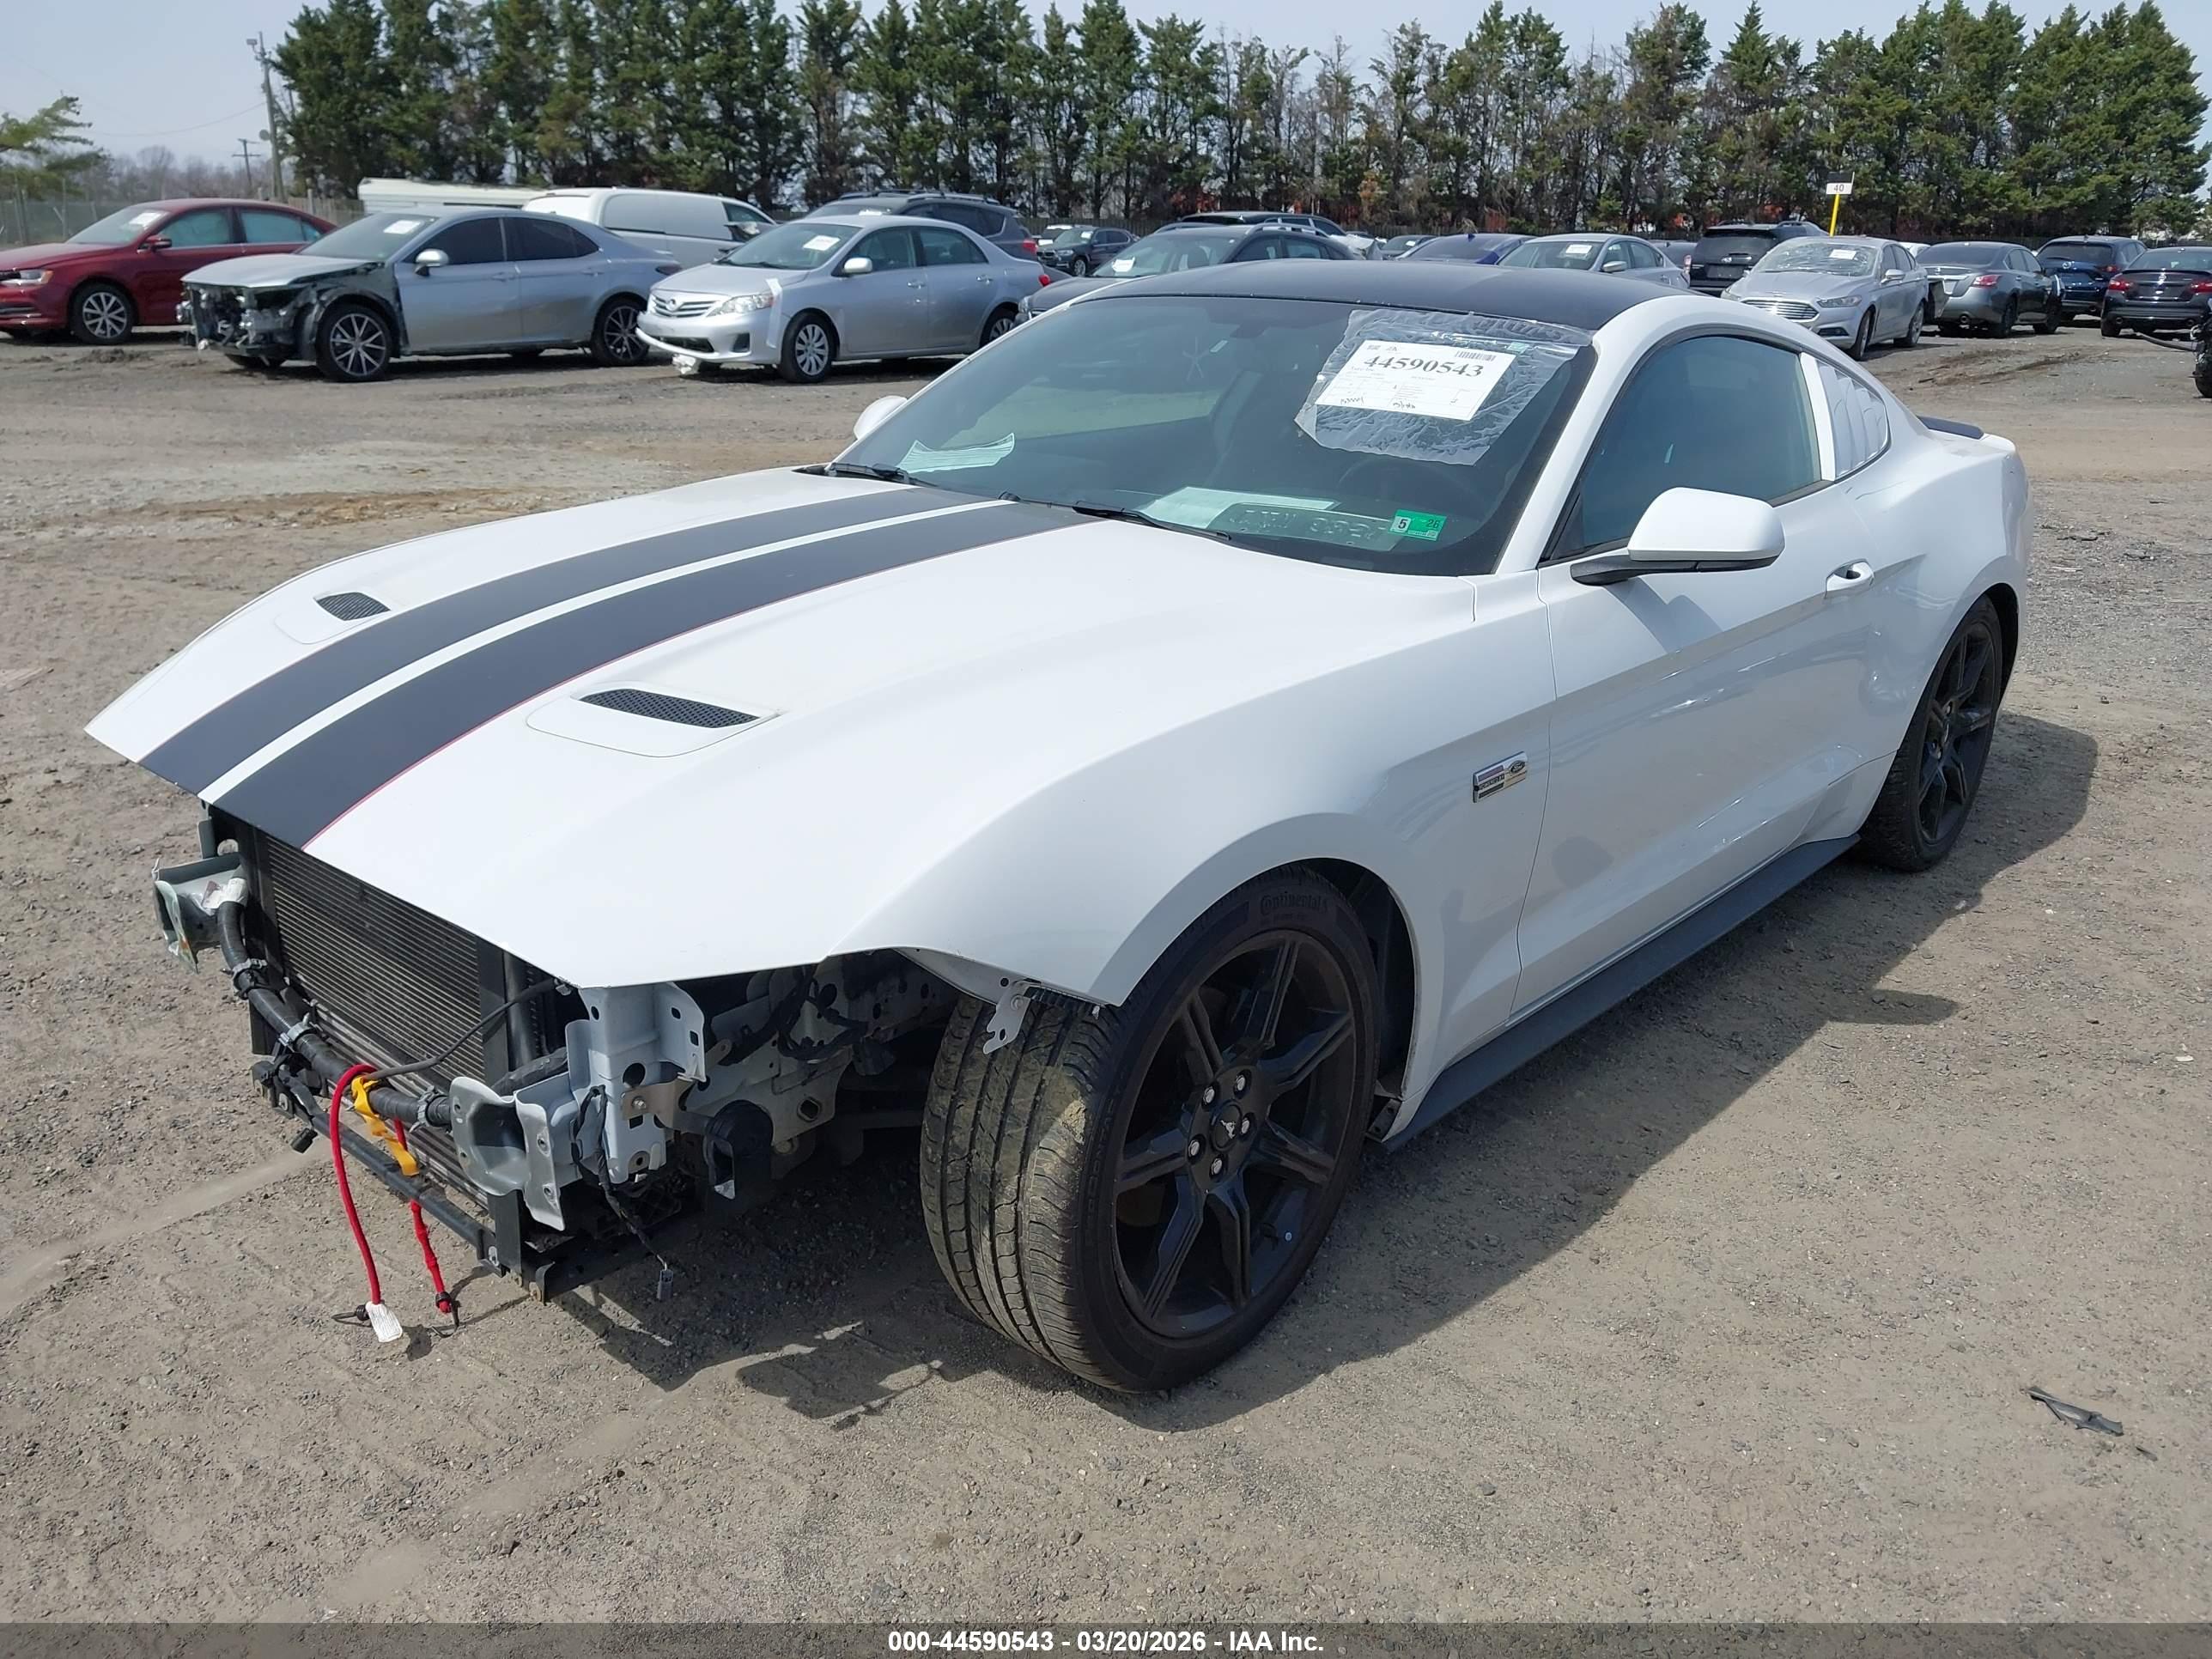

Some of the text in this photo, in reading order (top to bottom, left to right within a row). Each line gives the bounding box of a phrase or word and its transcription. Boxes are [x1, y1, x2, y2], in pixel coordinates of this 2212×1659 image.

[1364, 356, 1484, 377] 44590543
[1398, 519, 1408, 529] 5
[1260, 890, 1321, 916] Continental
